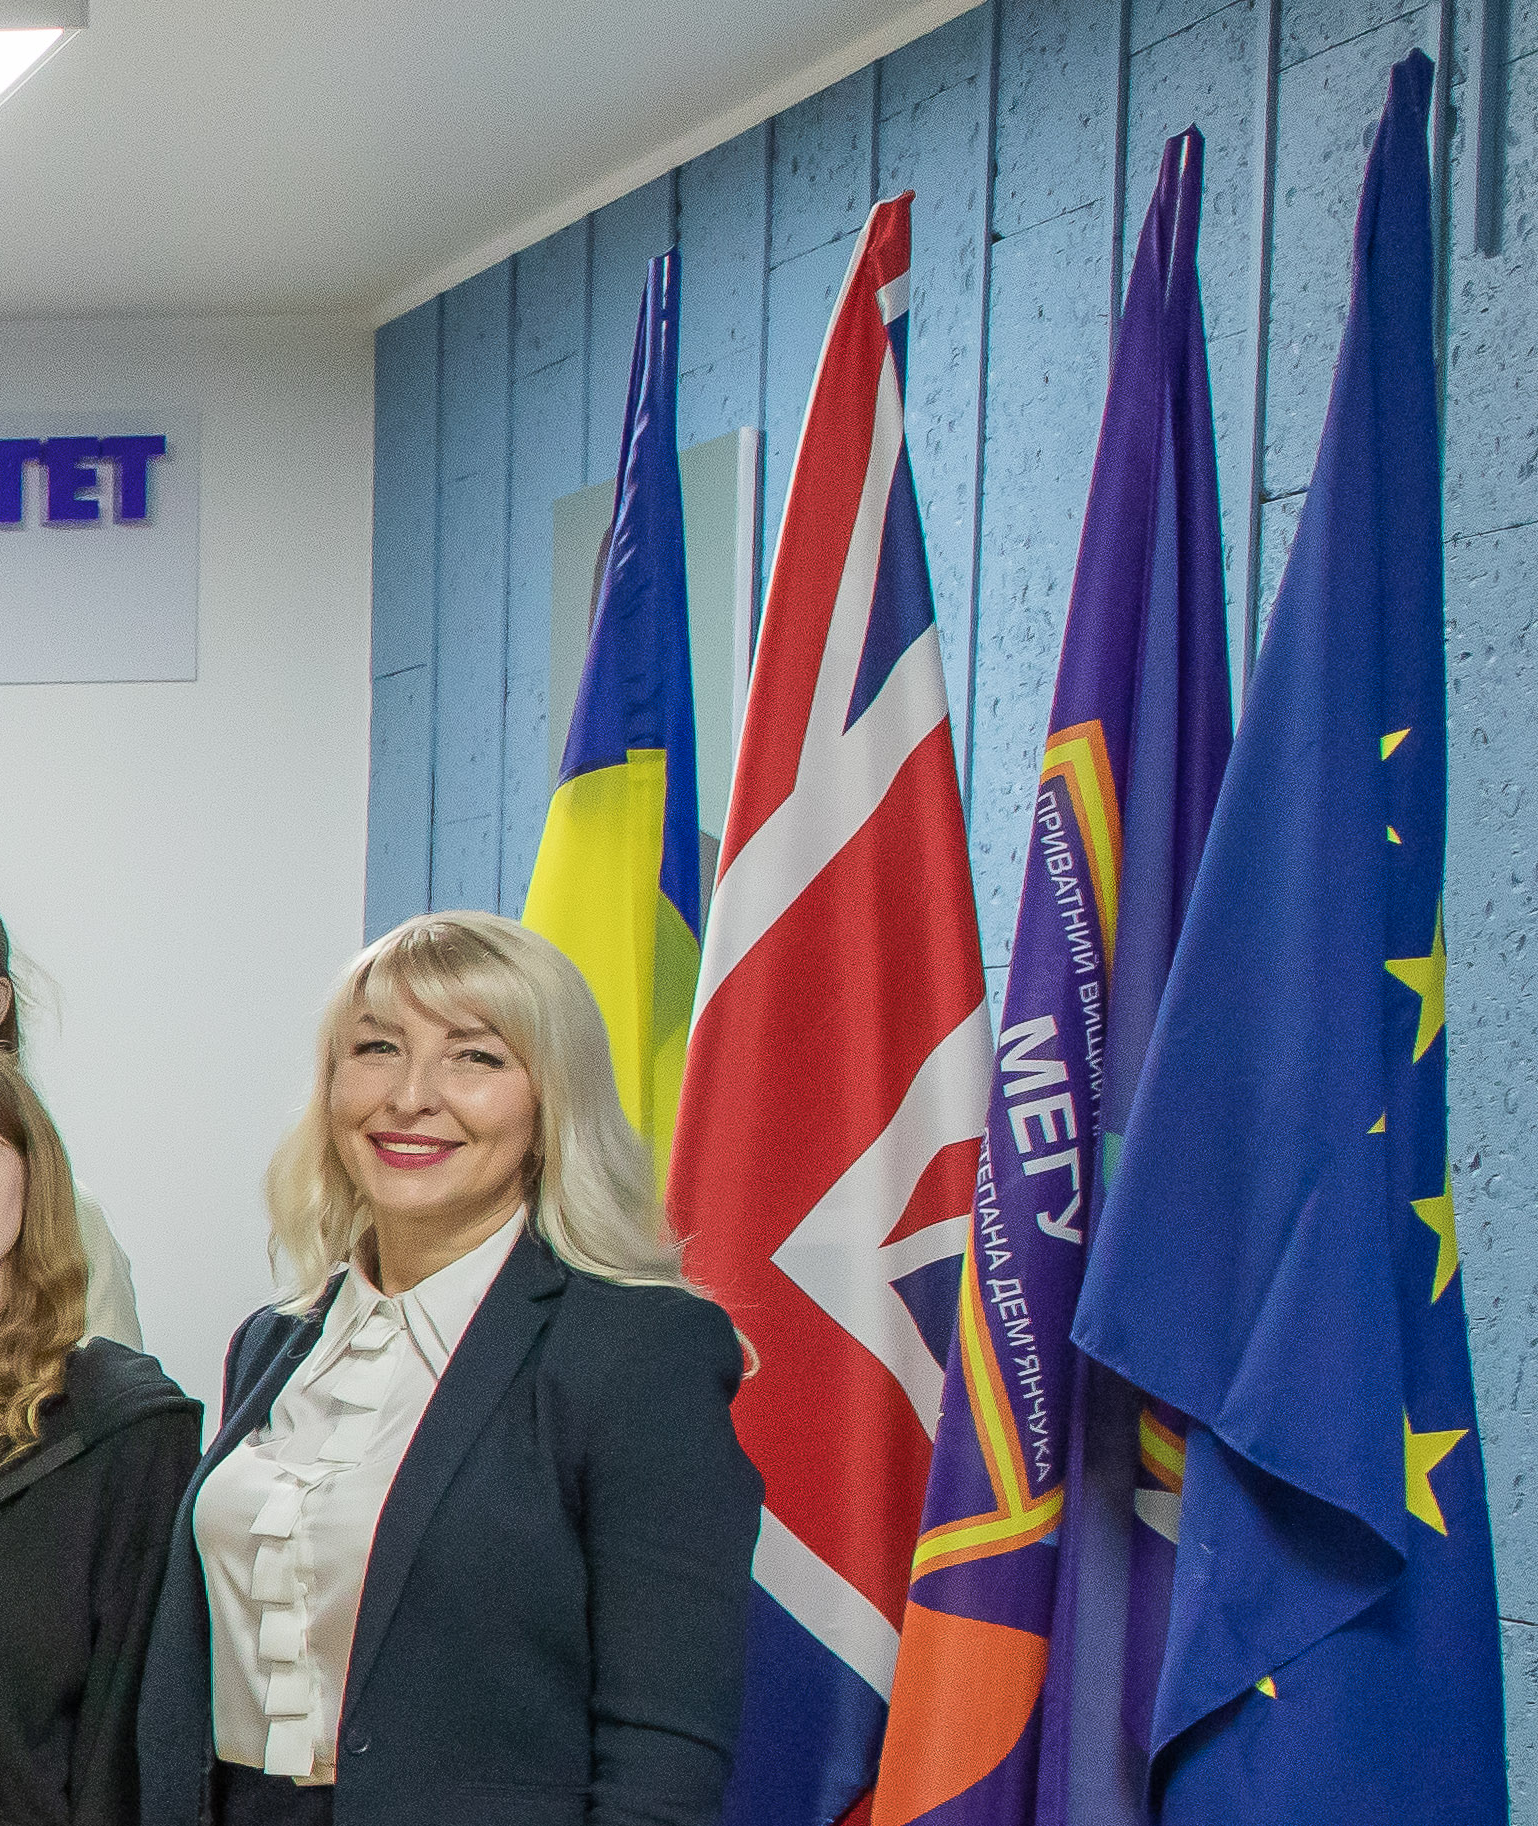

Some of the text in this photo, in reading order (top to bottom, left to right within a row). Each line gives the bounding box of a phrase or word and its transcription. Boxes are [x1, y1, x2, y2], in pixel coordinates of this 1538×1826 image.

[1037, 790, 1101, 975] ПРИВАТНИЙ
[999, 1014, 1083, 1246] МЕГУ
[986, 1278, 1052, 1482] ДЕМ'ЯНЧУКА
